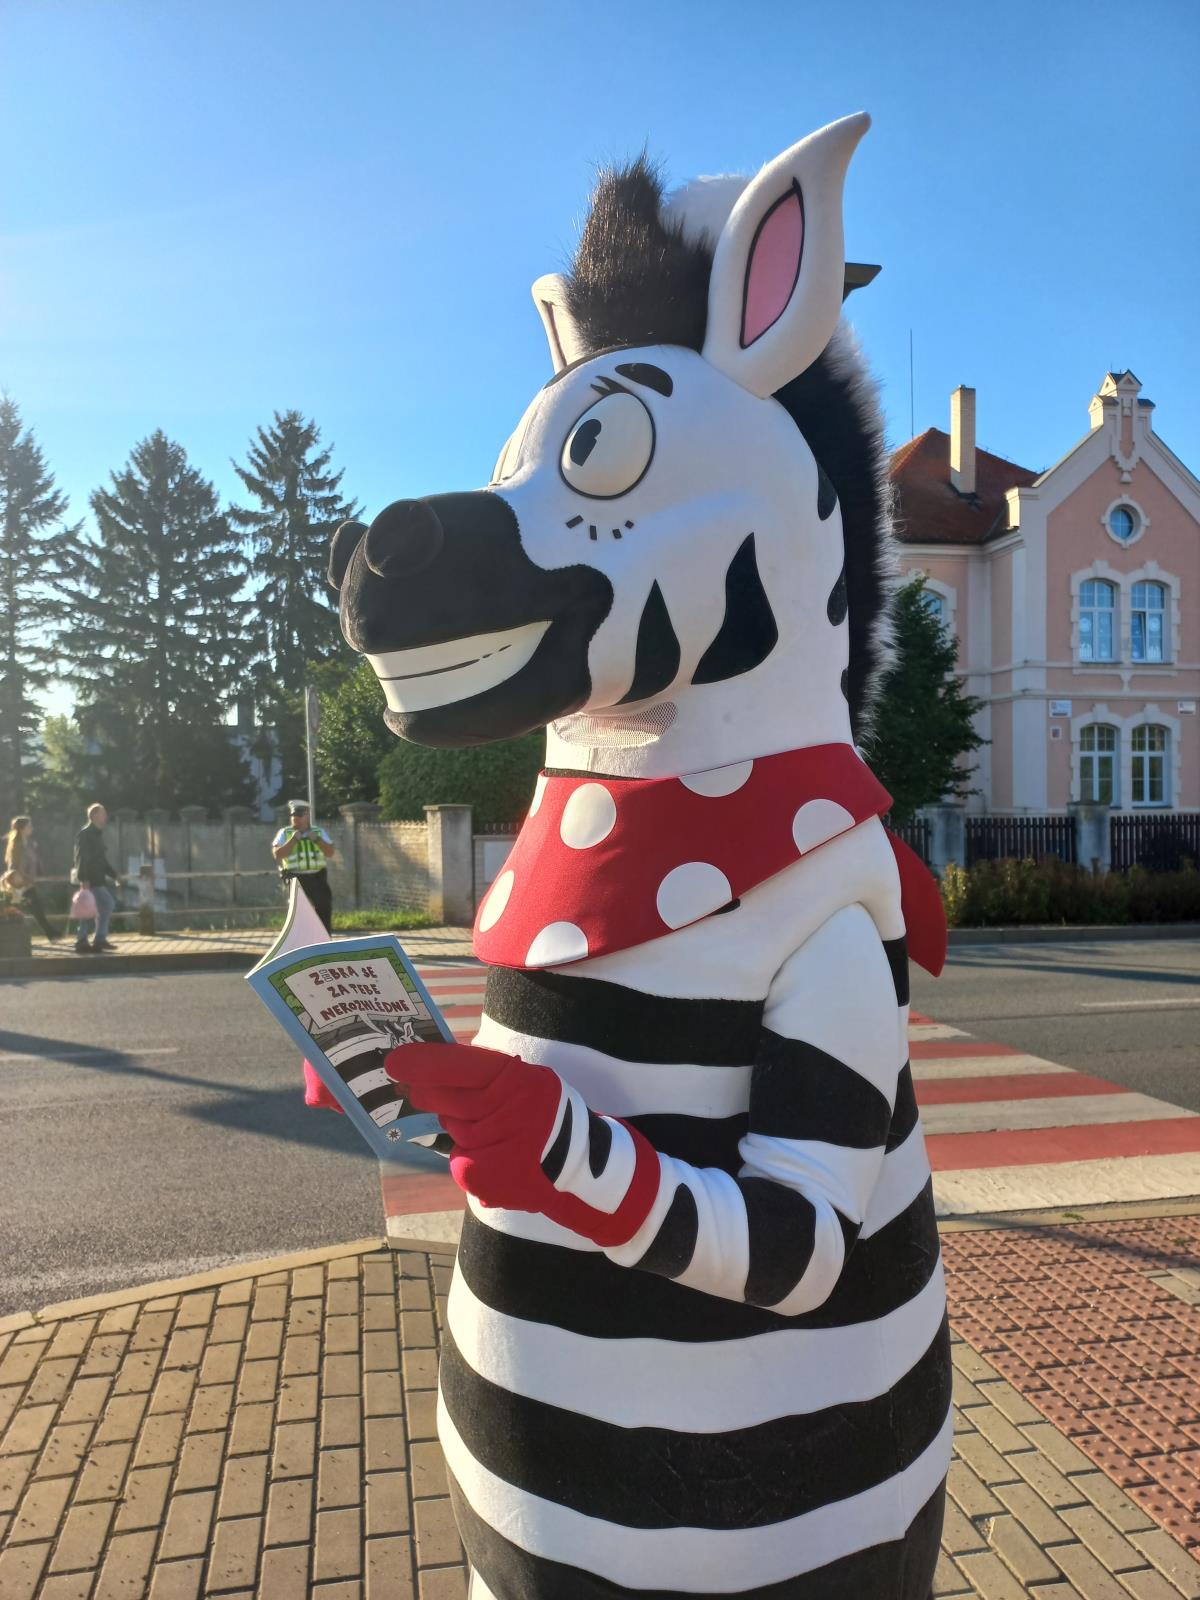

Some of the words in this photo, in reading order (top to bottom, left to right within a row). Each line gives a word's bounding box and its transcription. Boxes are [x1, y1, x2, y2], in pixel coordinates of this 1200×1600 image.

[361, 966, 378, 978] SE
[327, 984, 350, 998] ZA
[349, 984, 381, 995] TEBE
[320, 997, 410, 1021] NEROZHLÉDNE
